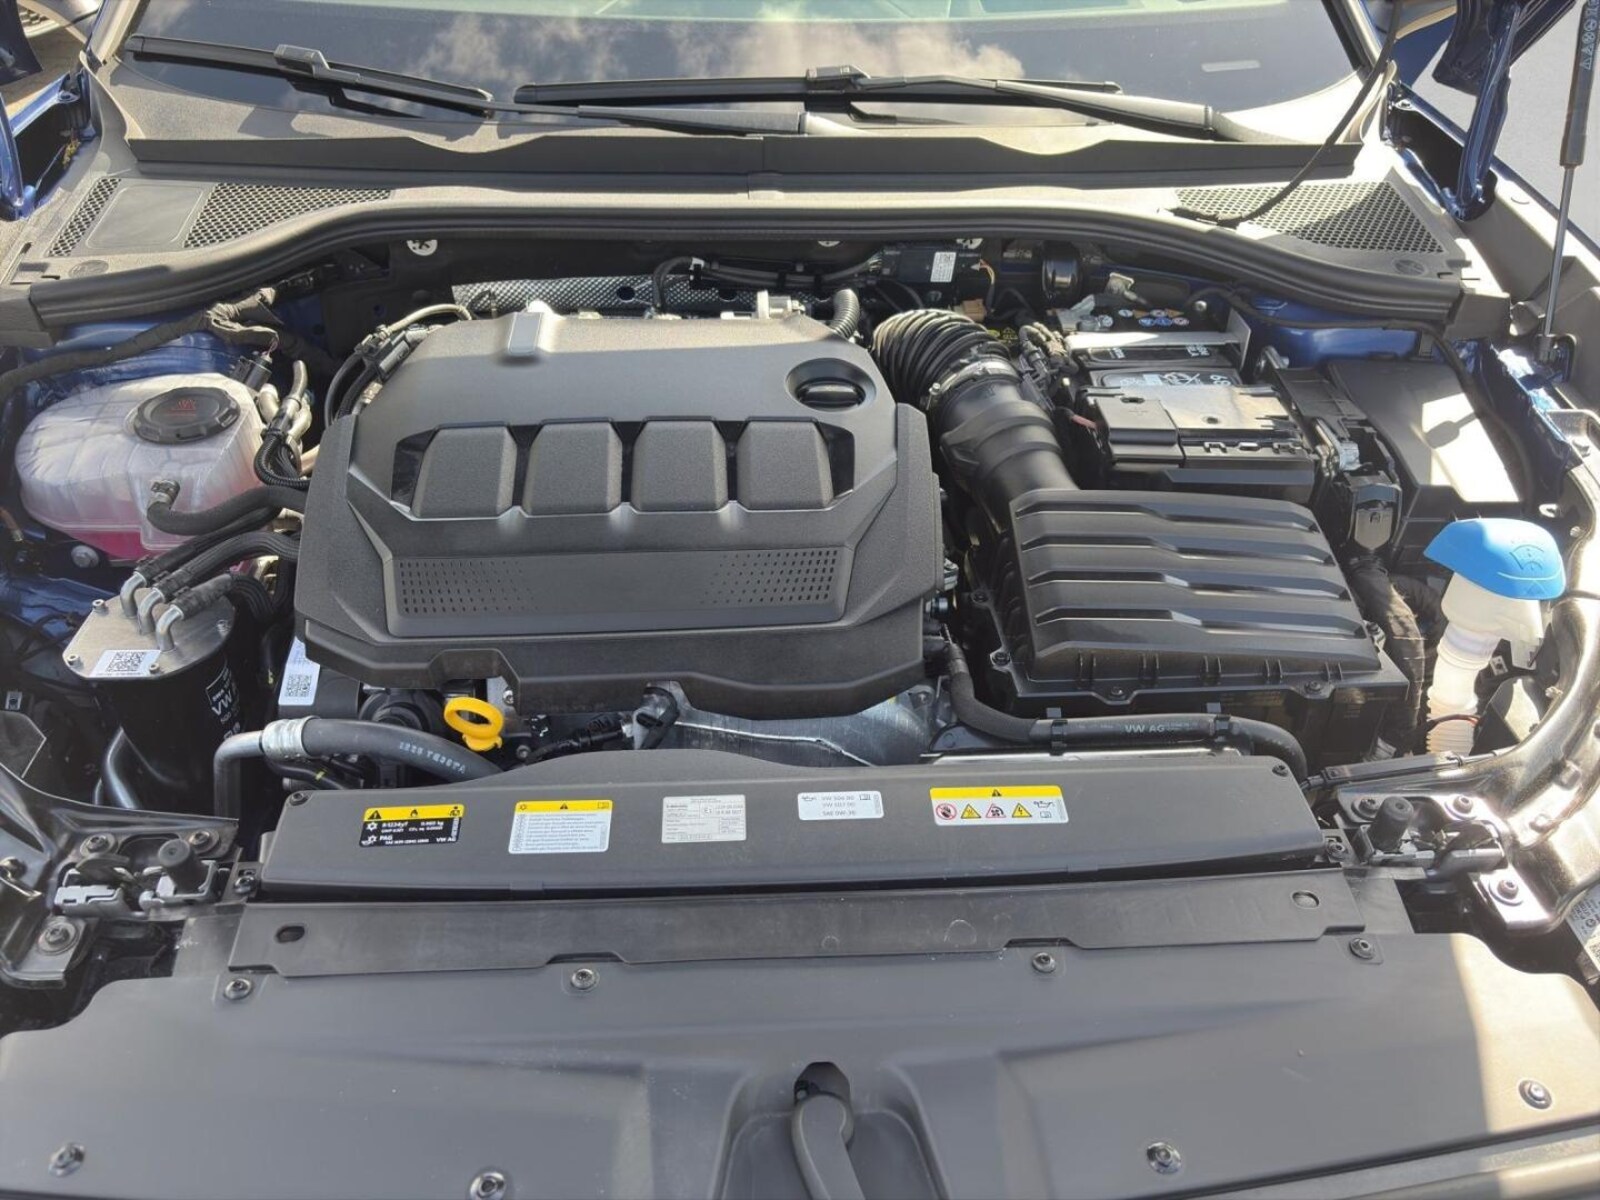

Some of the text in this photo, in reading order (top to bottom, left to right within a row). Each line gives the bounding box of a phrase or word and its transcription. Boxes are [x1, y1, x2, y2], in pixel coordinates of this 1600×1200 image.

[211, 690, 233, 716] VW
[1124, 724, 1146, 733] VW
[1149, 724, 1165, 733] AG
